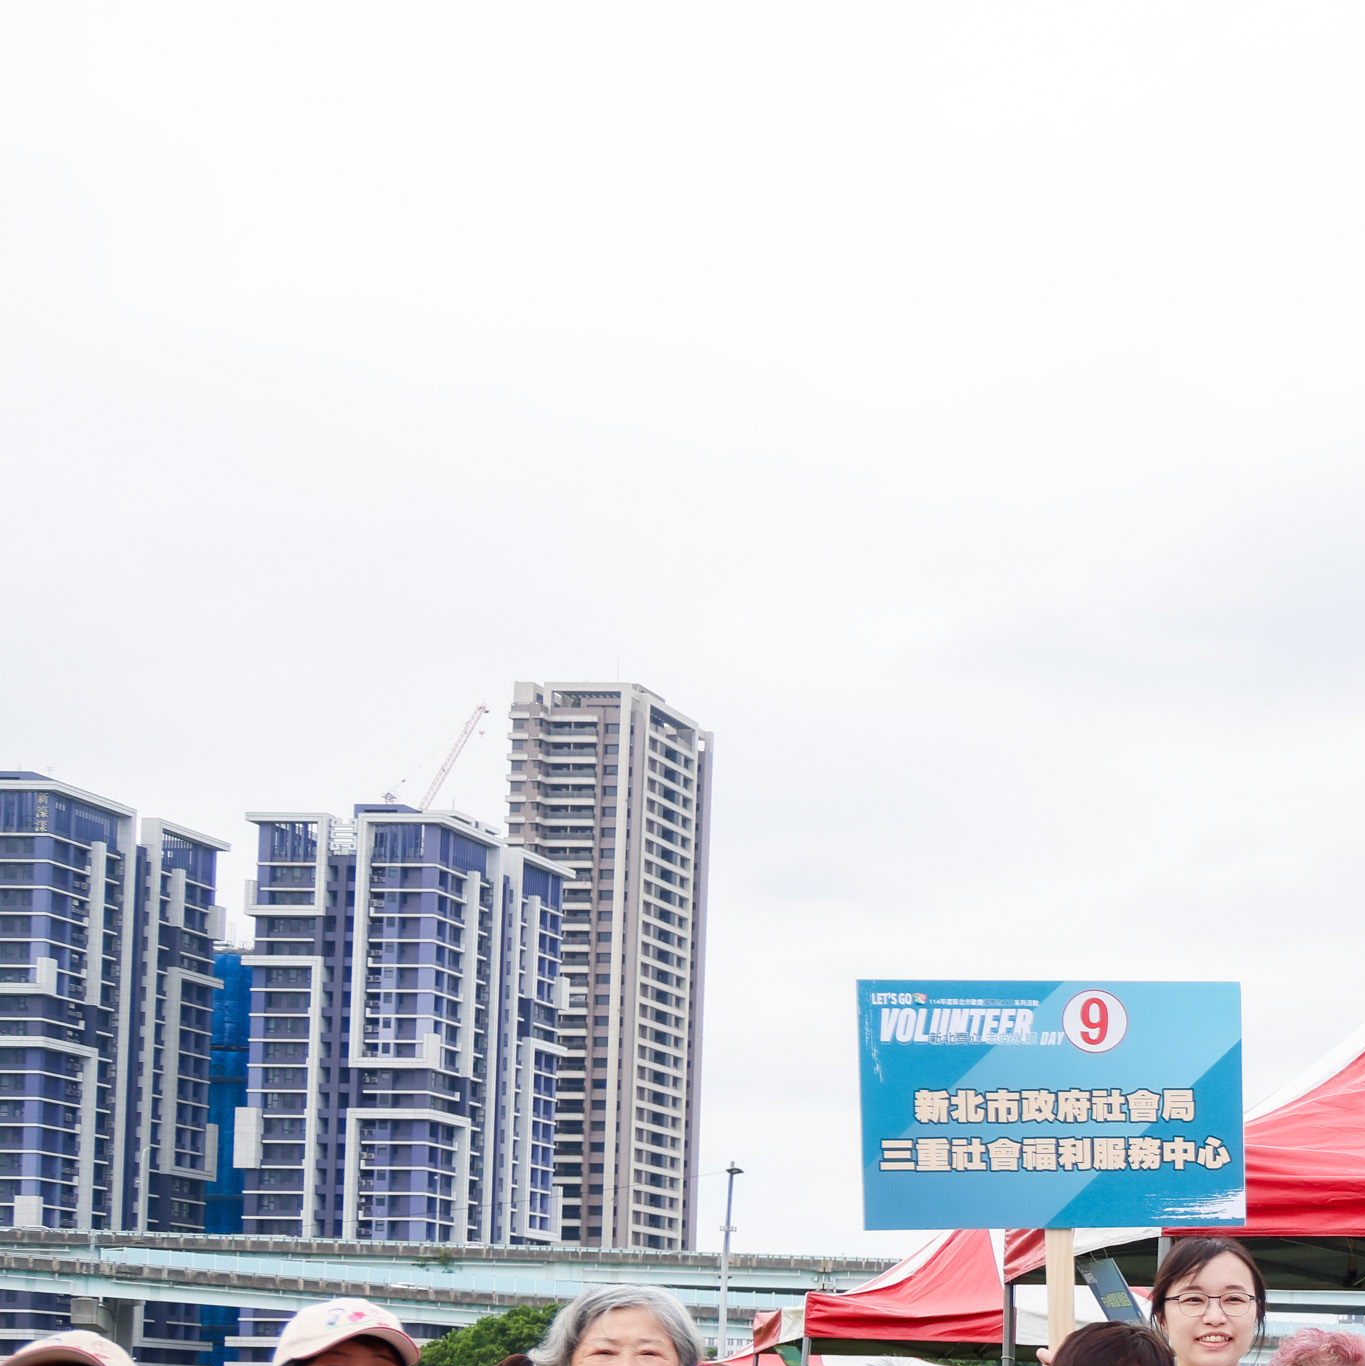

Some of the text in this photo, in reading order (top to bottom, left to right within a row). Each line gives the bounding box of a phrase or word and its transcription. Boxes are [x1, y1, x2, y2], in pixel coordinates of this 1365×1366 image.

[871, 992, 912, 1005] LET'S GO
[879, 1007, 1065, 1046] VOLUNTEER DAY
[1079, 997, 1109, 1045] 9
[913, 1087, 1196, 1125] 新北市政府社會局
[879, 1135, 1232, 1173] 三重社會福利服務中心
